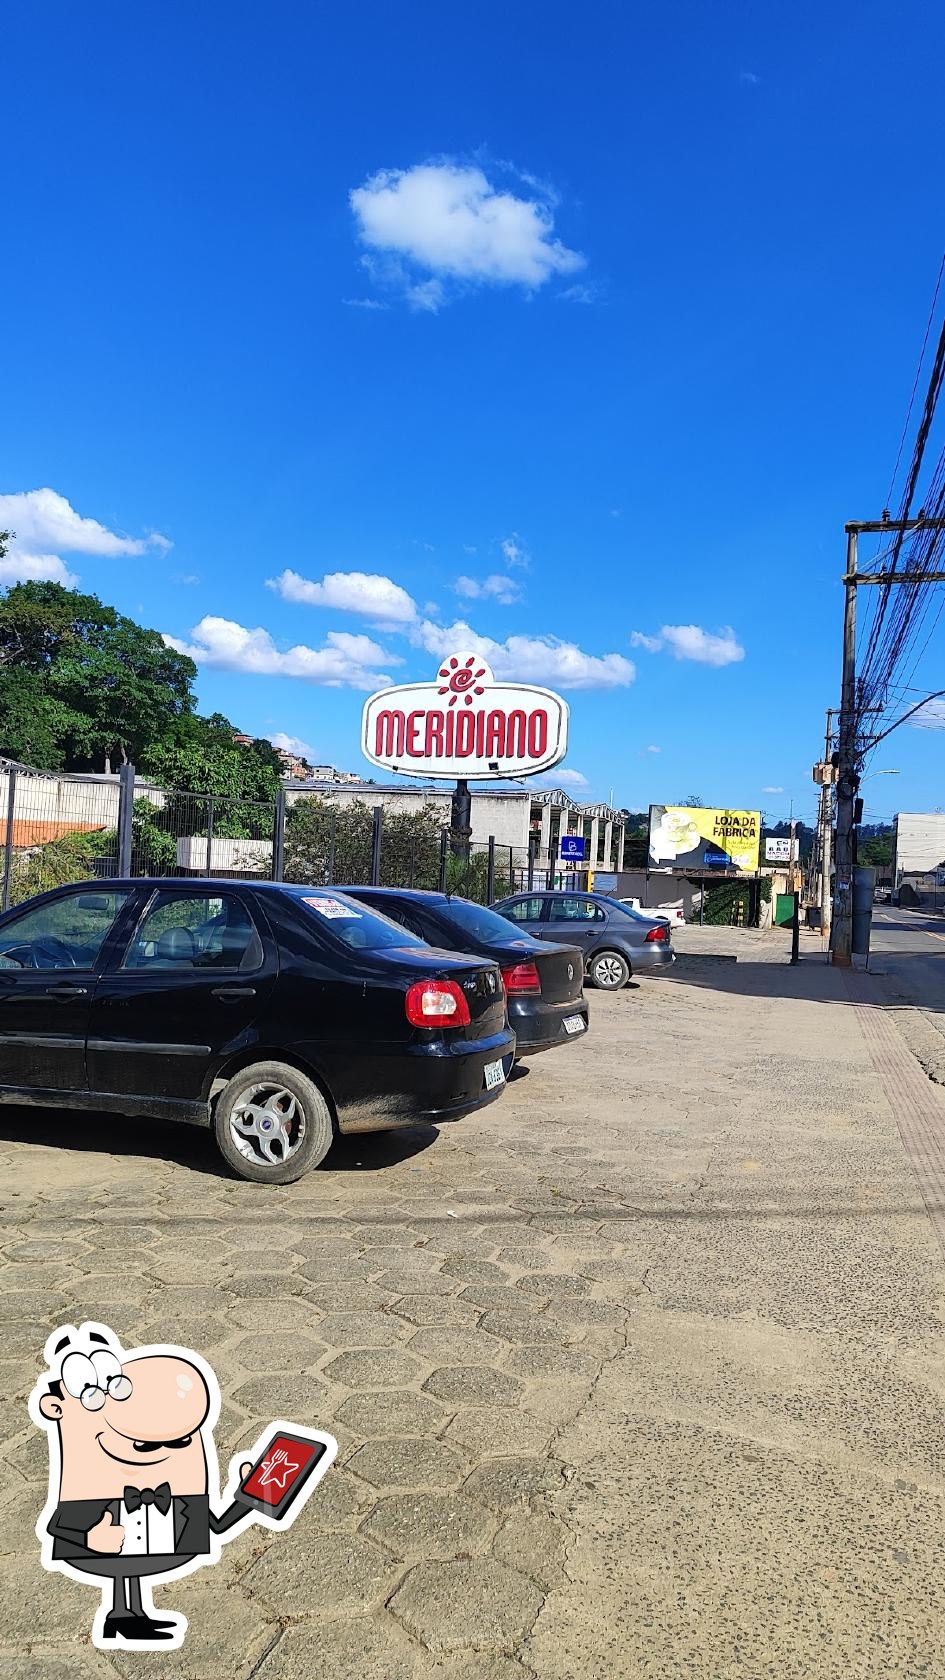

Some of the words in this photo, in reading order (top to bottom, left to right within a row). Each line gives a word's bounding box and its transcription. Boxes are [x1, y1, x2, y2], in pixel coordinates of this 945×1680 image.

[375, 709, 548, 758] MERIDIANO
[715, 816, 739, 826] LOJA
[742, 817, 756, 827] DA
